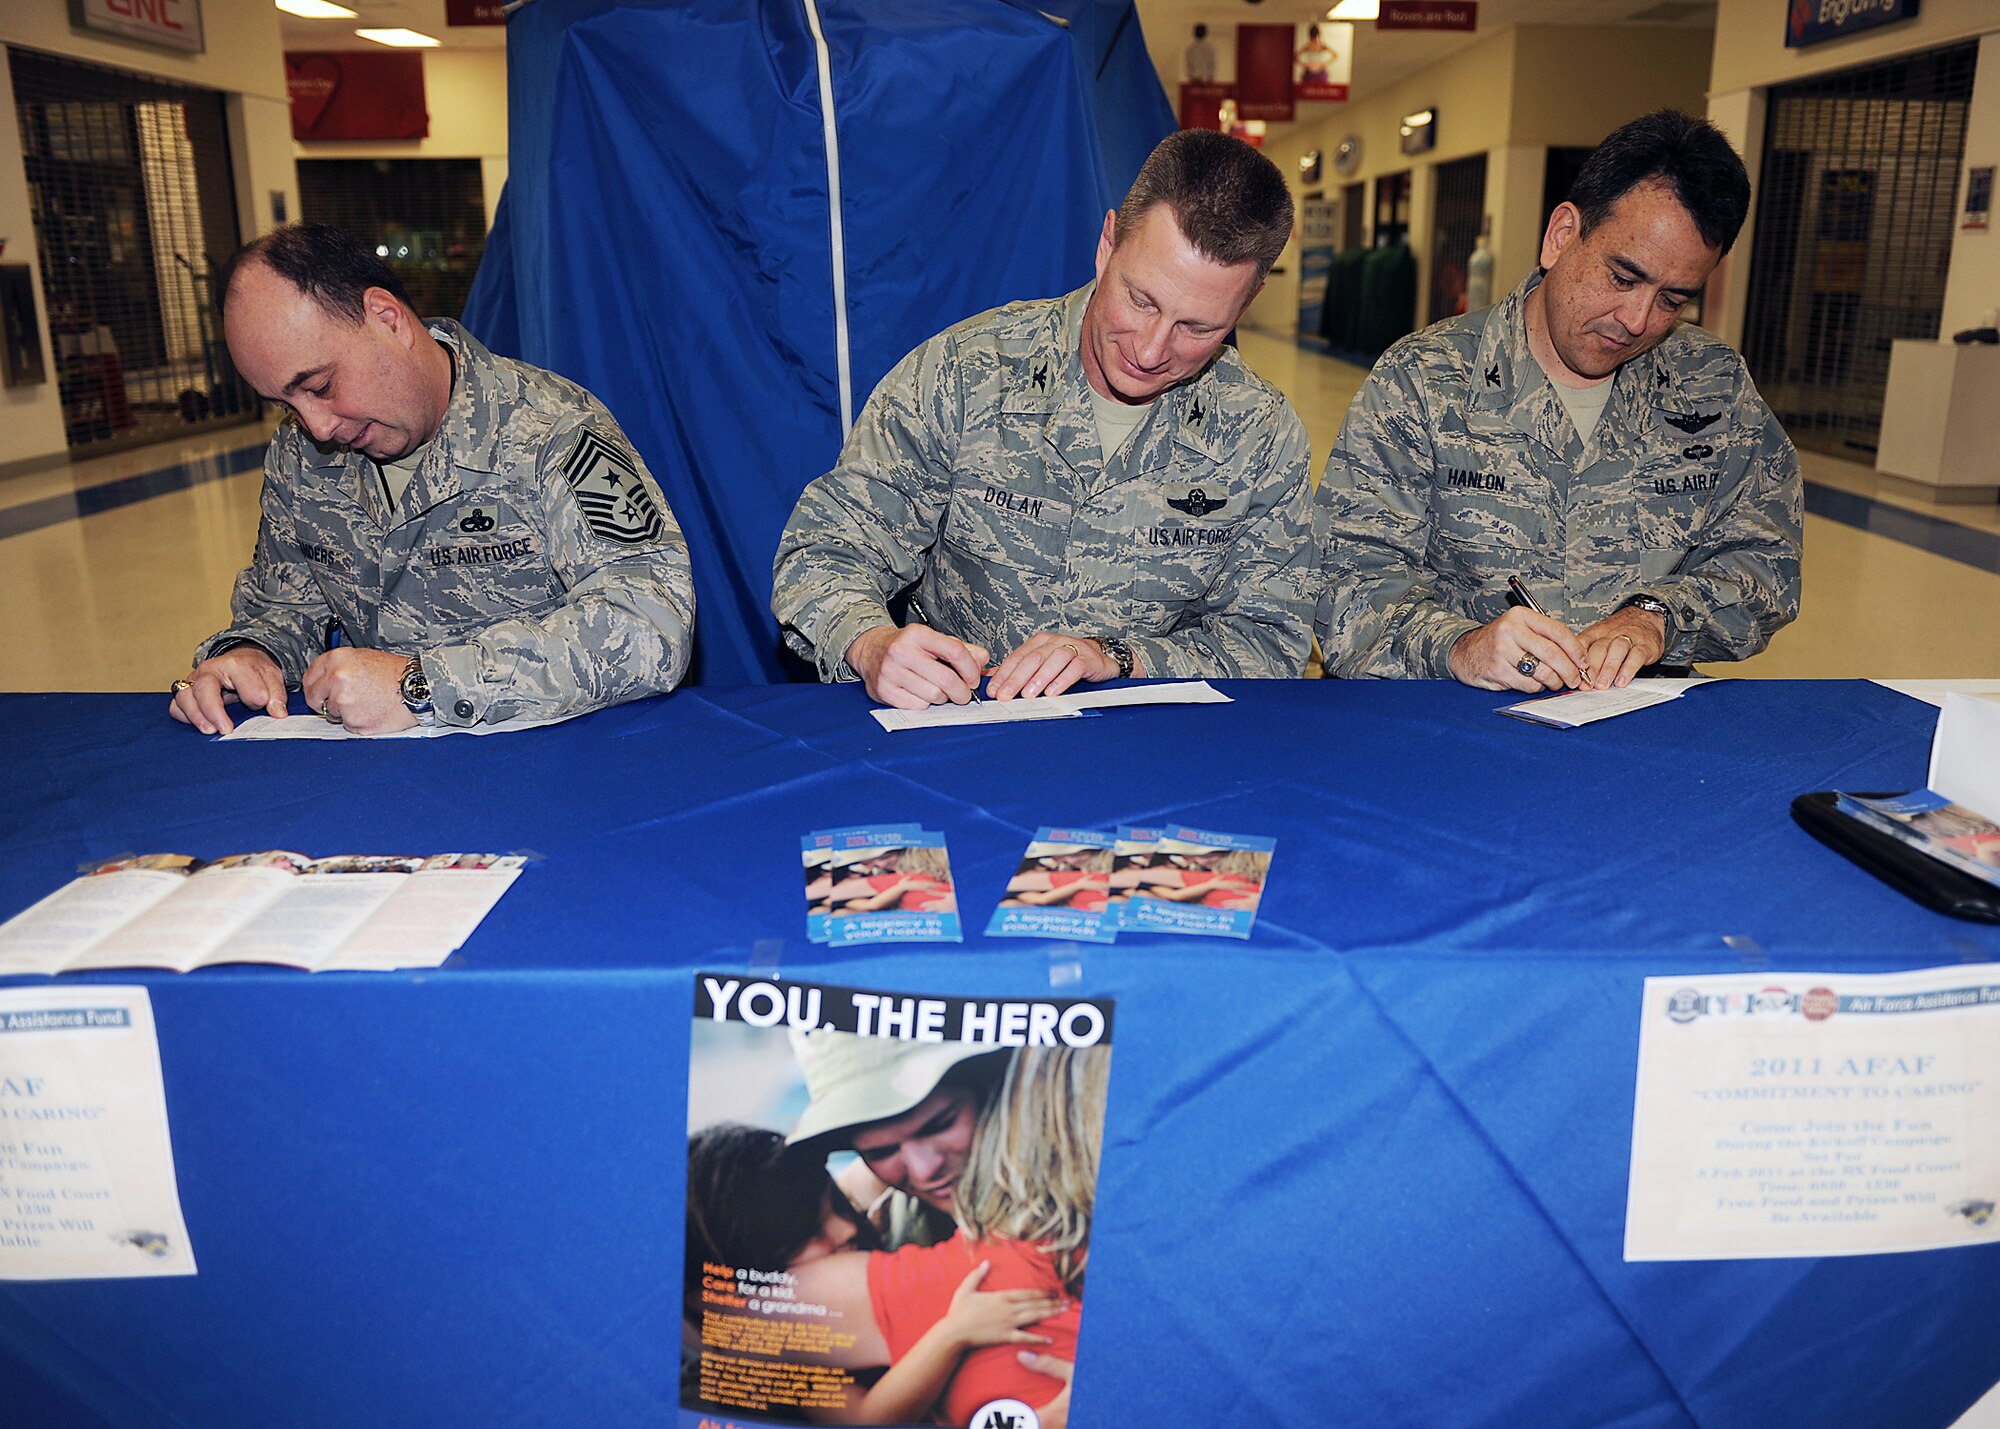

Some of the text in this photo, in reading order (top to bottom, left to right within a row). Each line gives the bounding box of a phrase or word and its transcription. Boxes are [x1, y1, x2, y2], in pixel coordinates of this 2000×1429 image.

[1447, 469, 1505, 492] HANLON
[1654, 479, 1680, 495] U.S.
[1682, 474, 1707, 492] AIR
[984, 487, 1043, 518] DOLAN
[1149, 528, 1233, 546] U.S. AIR FORC
[300, 541, 335, 566] NDERS
[431, 537, 535, 567] U.S. AIR FORCE
[1914, 990, 1979, 1009] Assistance
[8, 1009, 84, 1031] Assistance
[86, 1007, 123, 1026] Fund
[704, 977, 1106, 1048] YOU, THE HERO
[1749, 1055, 1936, 1077] 2011 AFAF
[1861, 1086, 1889, 1099] TO
[1801, 1119, 1847, 1133] Join
[1853, 1119, 1886, 1132] the
[1893, 1118, 1933, 1132] Fun
[22, 1141, 63, 1155] Fun
[8, 1158, 92, 1173] Campaign
[15, 1186, 56, 1201] Food
[60, 1187, 112, 1201] Court
[3, 1218, 94, 1232] Prizes Will
[703, 1261, 735, 1279] Help
[736, 1268, 748, 1280] a
[702, 1276, 737, 1293] Care
[738, 1281, 757, 1295] for
[758, 1286, 771, 1297] a
[702, 1290, 747, 1308] Shelter
[748, 1298, 760, 1310] a
[761, 1300, 828, 1317] grandma
